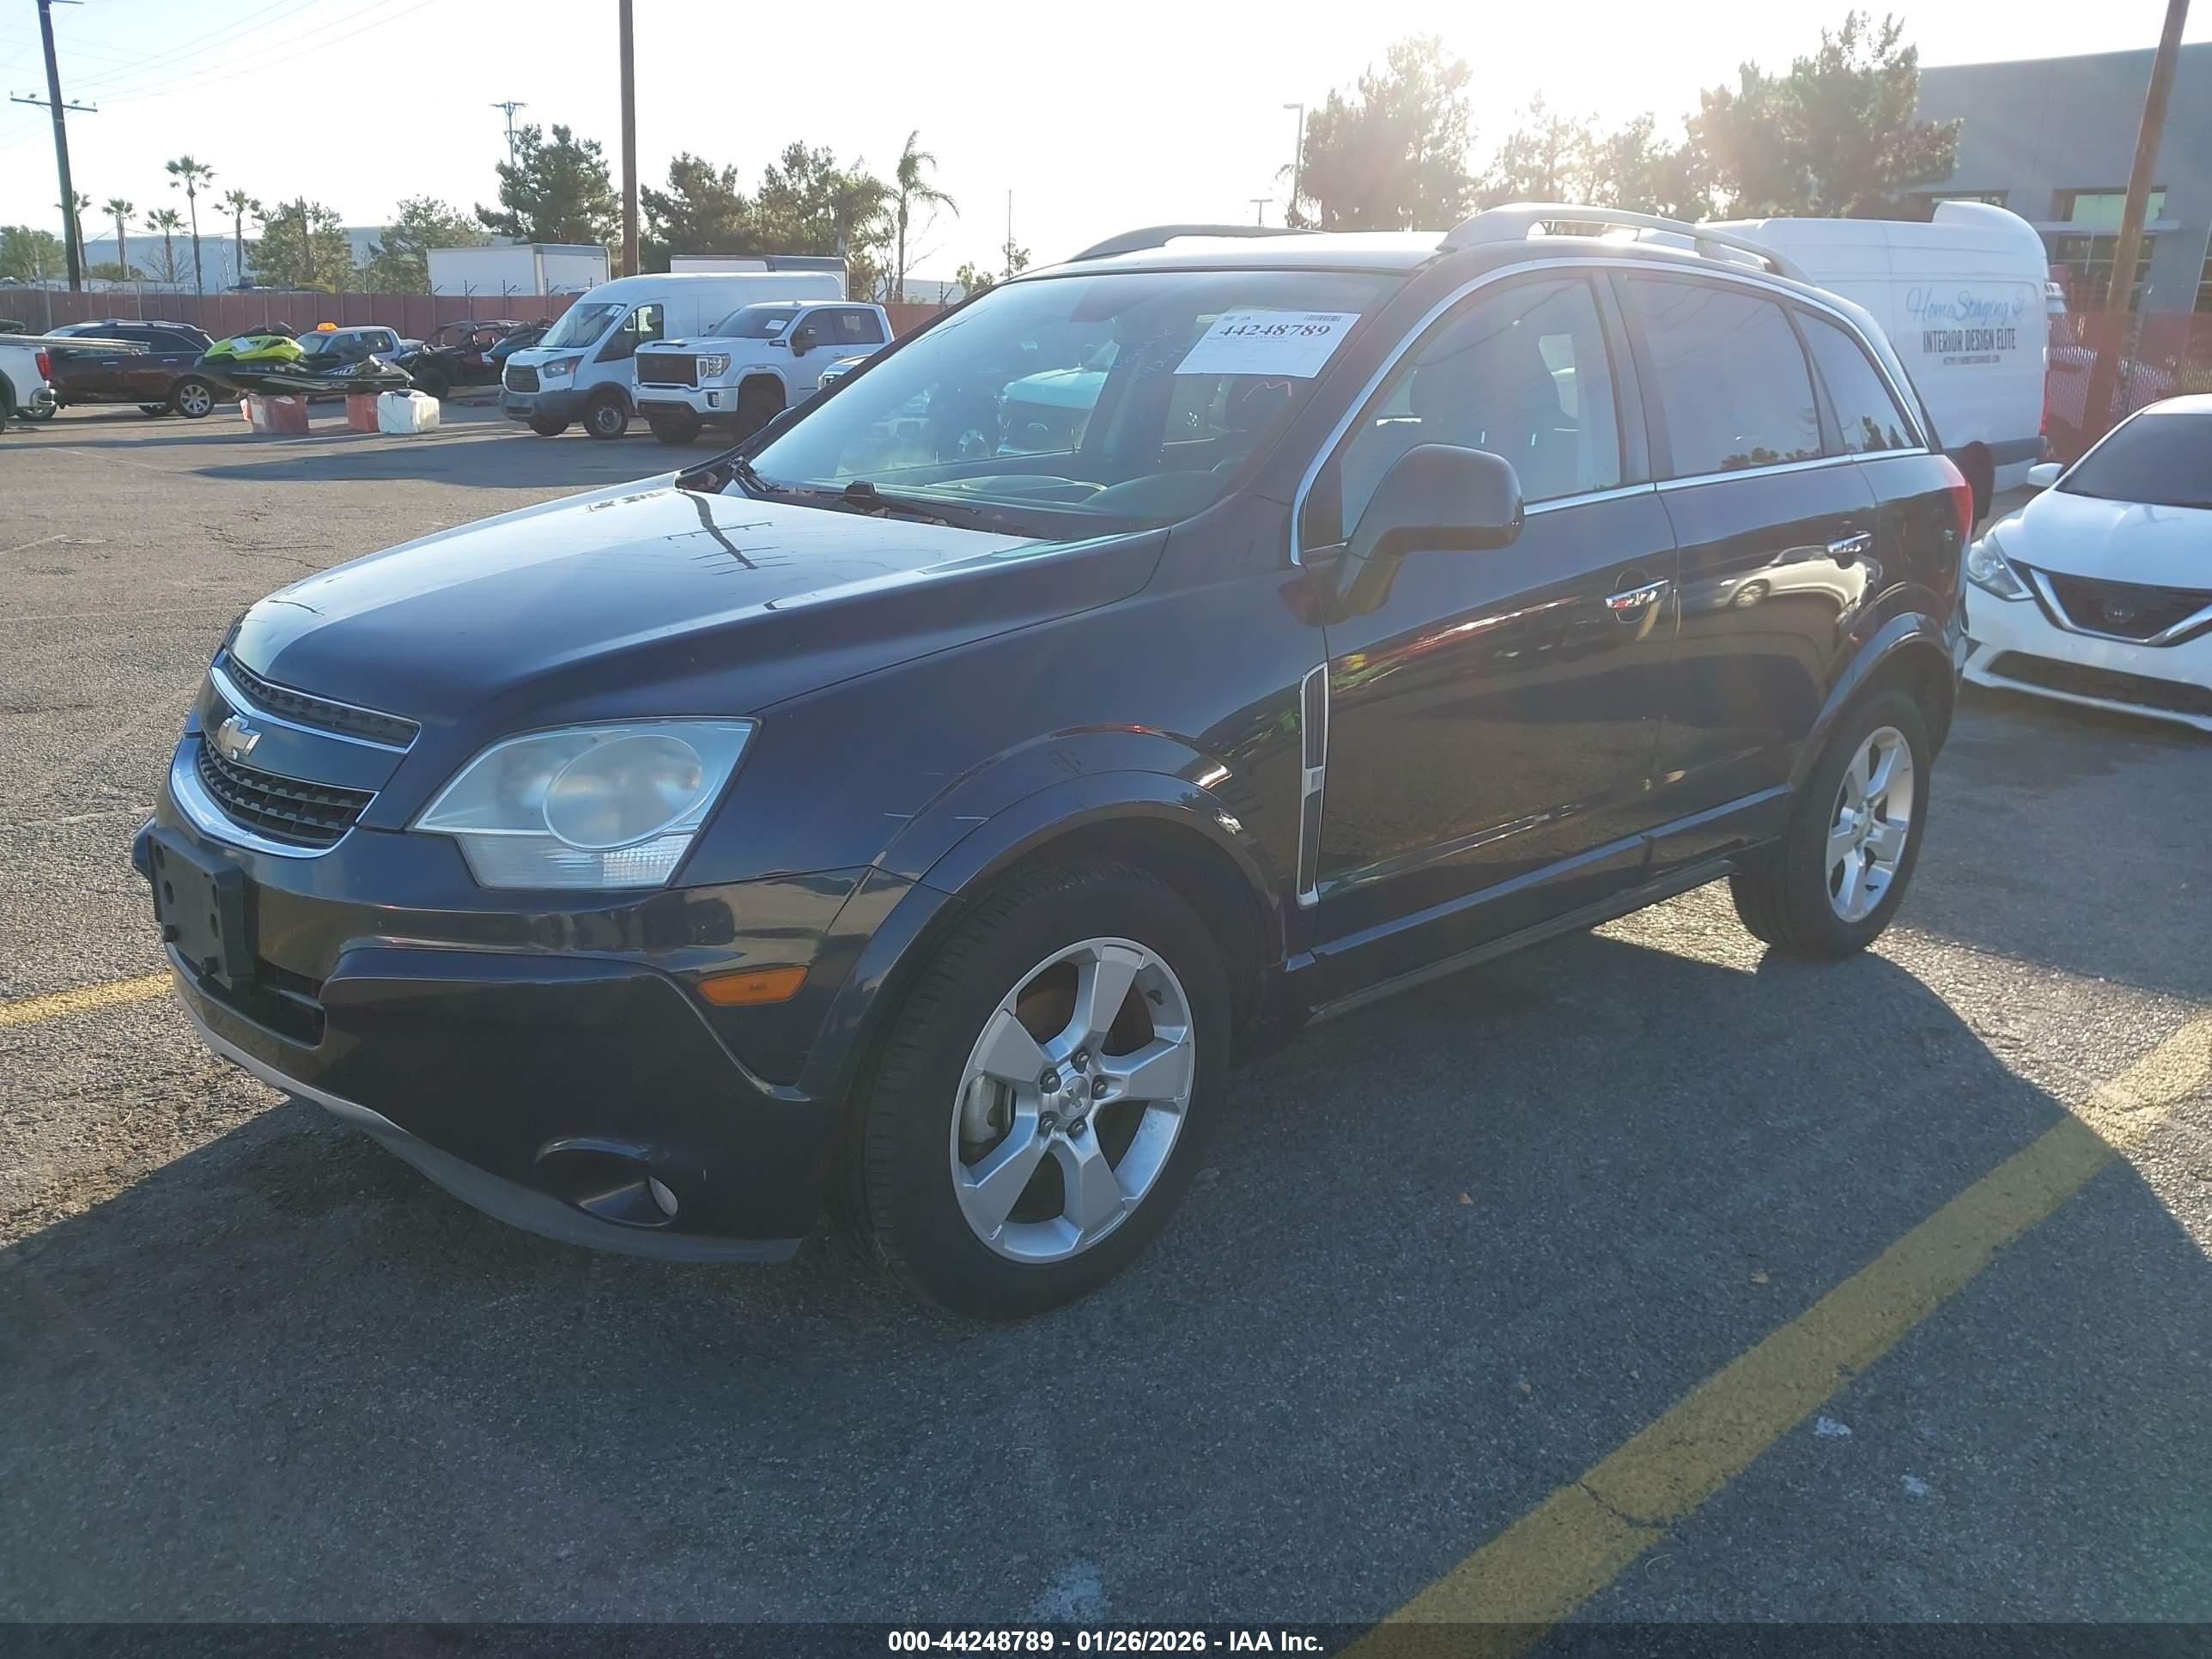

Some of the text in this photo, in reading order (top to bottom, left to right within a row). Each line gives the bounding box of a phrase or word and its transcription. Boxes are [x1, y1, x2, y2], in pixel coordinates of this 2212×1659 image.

[1906, 287, 1955, 322] Home
[1955, 289, 2008, 325] Staging
[1219, 324, 1332, 337] 44248789
[1923, 328, 2016, 353] INTERIOR DESIGN ELITE
